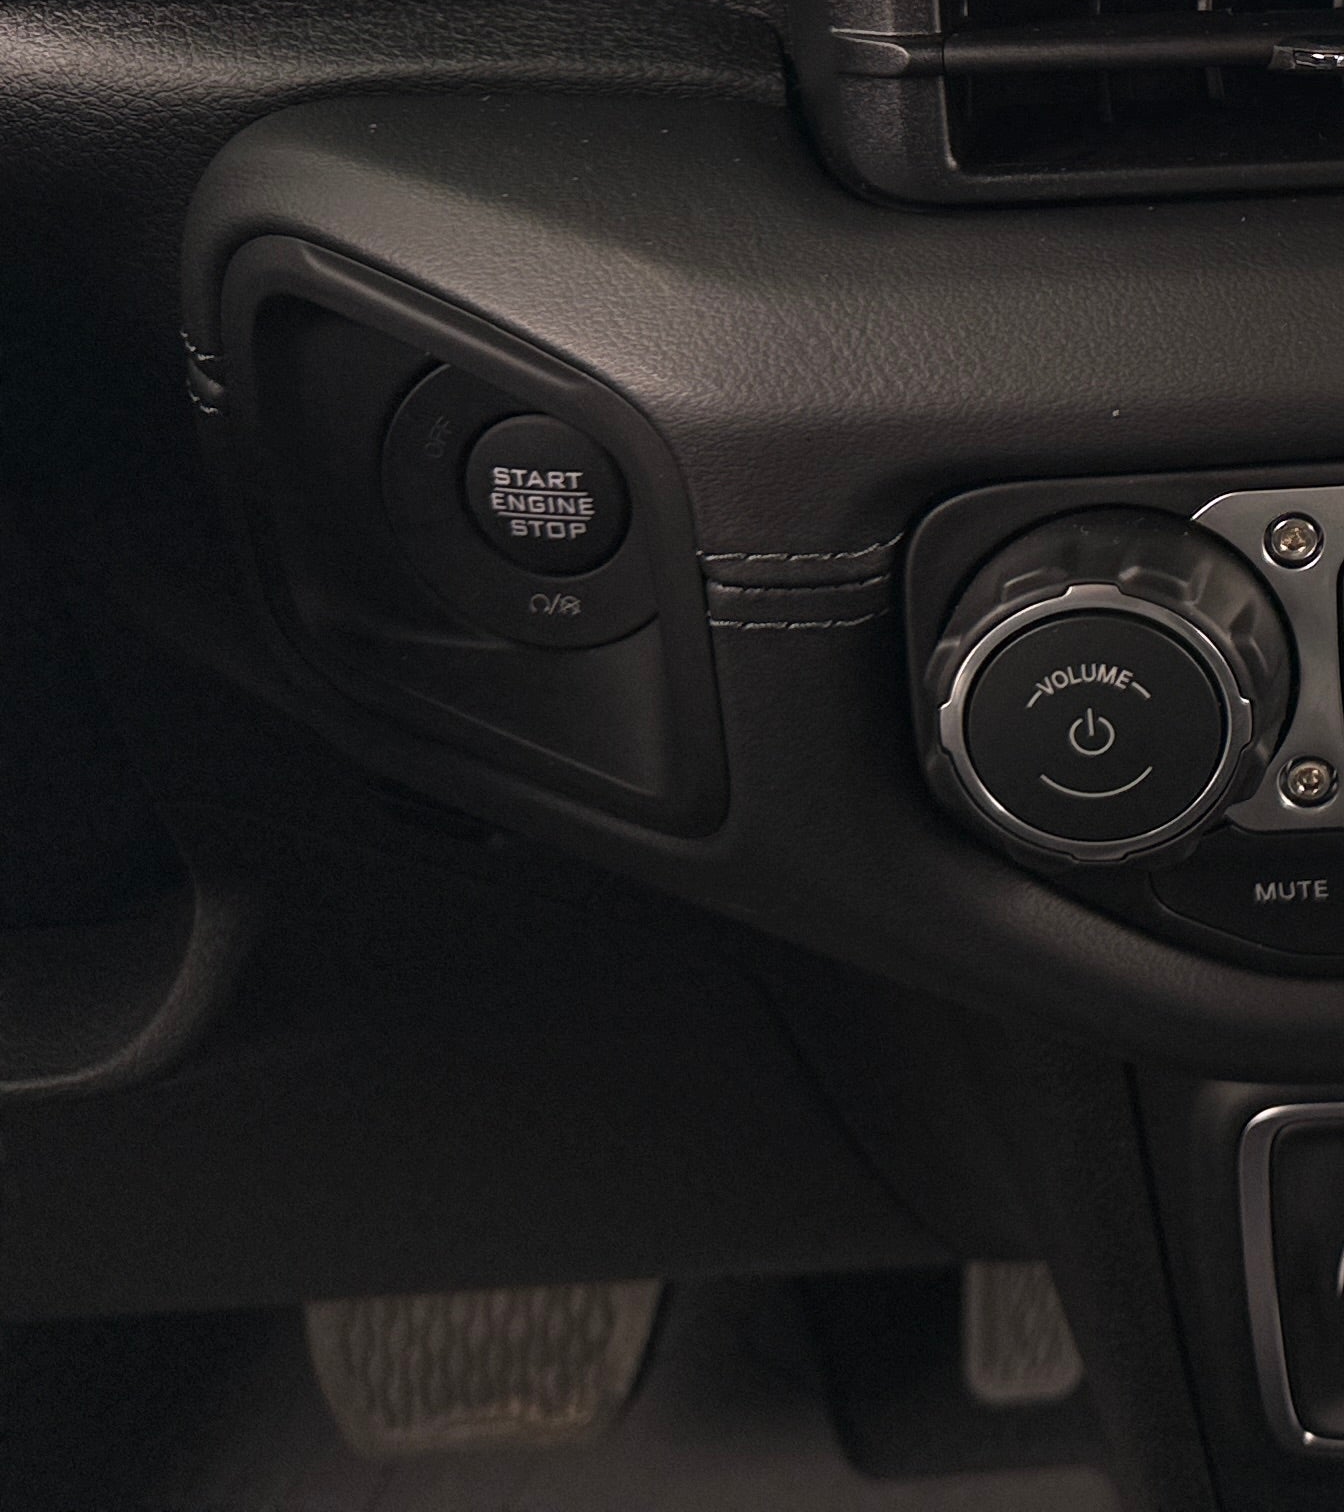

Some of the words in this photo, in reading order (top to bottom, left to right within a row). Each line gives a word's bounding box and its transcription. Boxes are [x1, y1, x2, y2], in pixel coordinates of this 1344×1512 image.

[491, 466, 584, 490] START
[490, 491, 596, 517] ENGINE
[509, 519, 588, 540] STOP
[1036, 662, 1135, 697] VOLUME
[1254, 879, 1330, 903] MUTE
